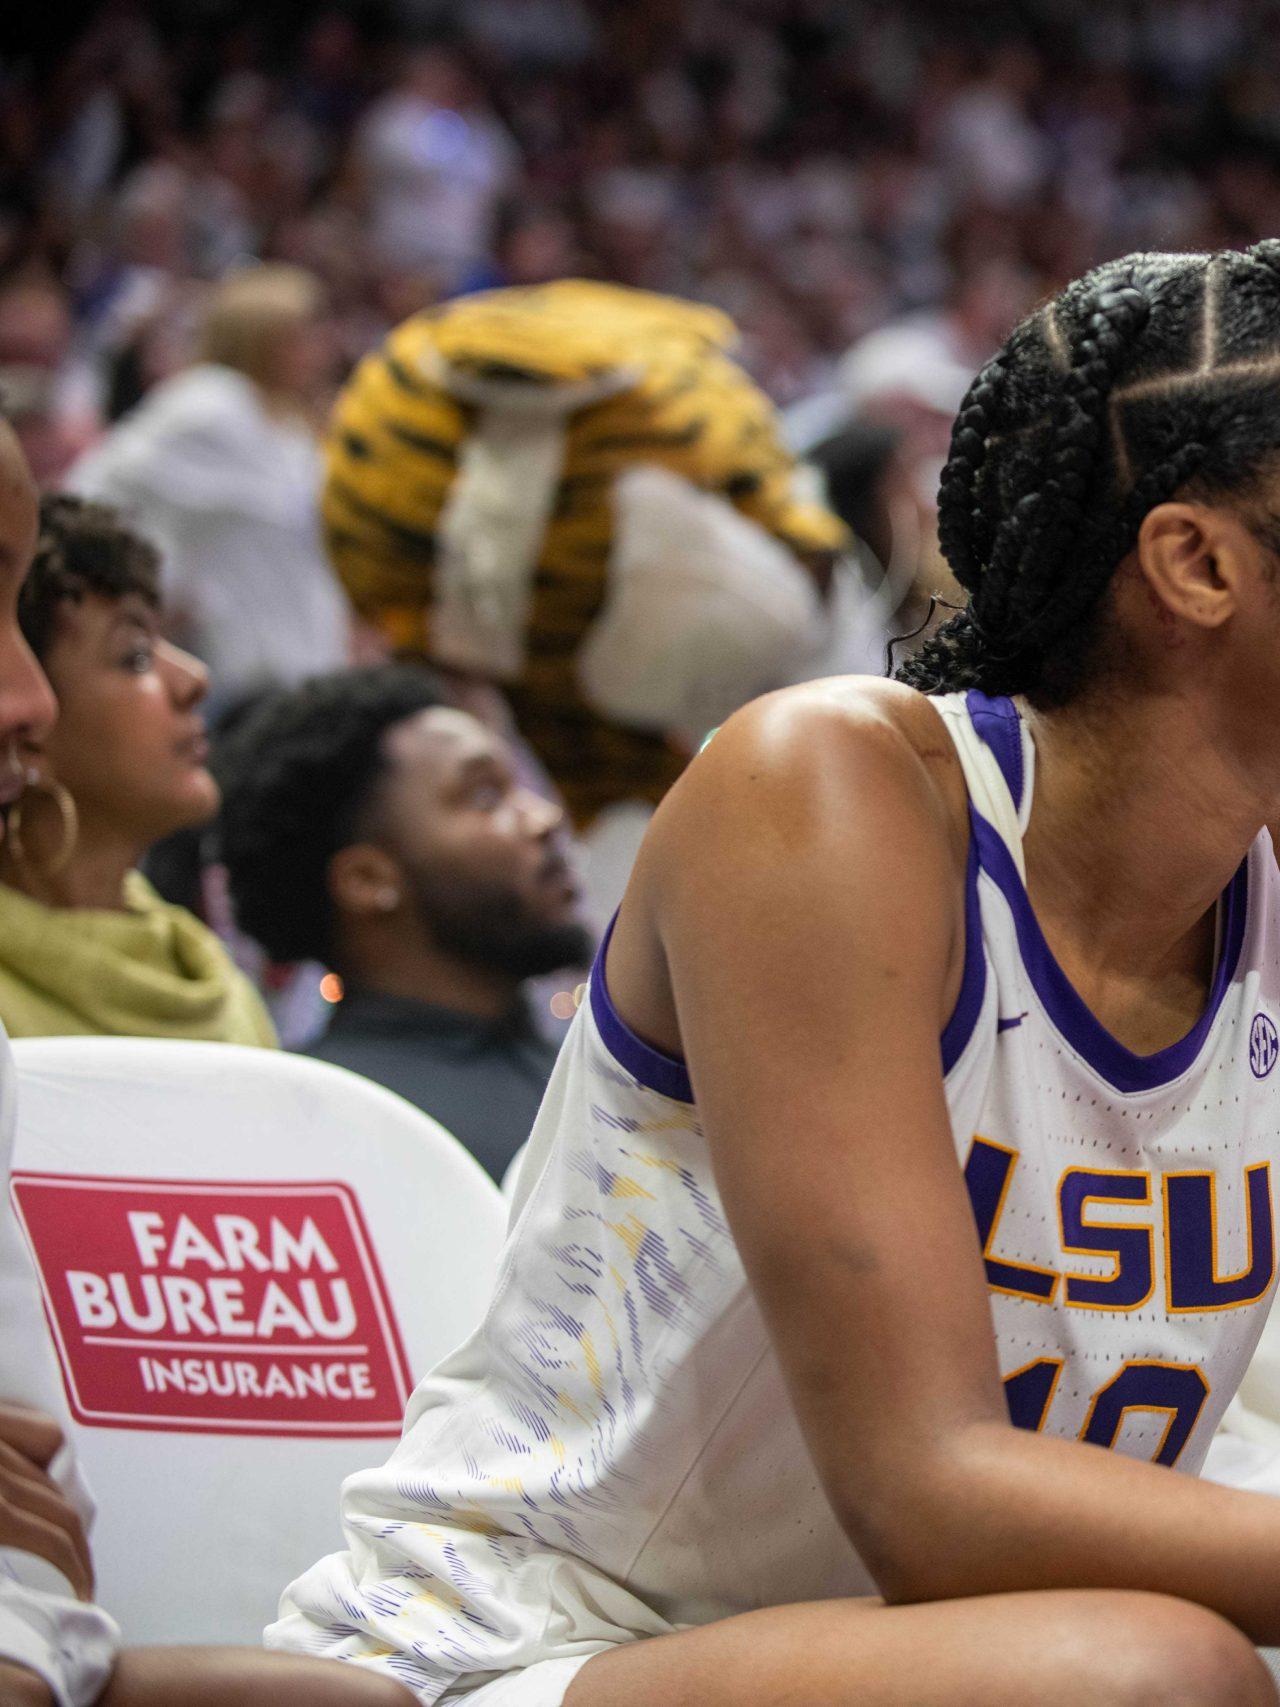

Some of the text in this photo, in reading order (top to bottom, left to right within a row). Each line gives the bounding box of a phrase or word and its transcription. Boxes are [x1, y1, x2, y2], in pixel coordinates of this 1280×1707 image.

[1251, 1015, 1278, 1075] SEC
[127, 1211, 339, 1273] FARM
[963, 1135, 1276, 1313] LSU
[65, 1270, 357, 1339] BUREAU
[138, 1356, 376, 1400] INSURANCE
